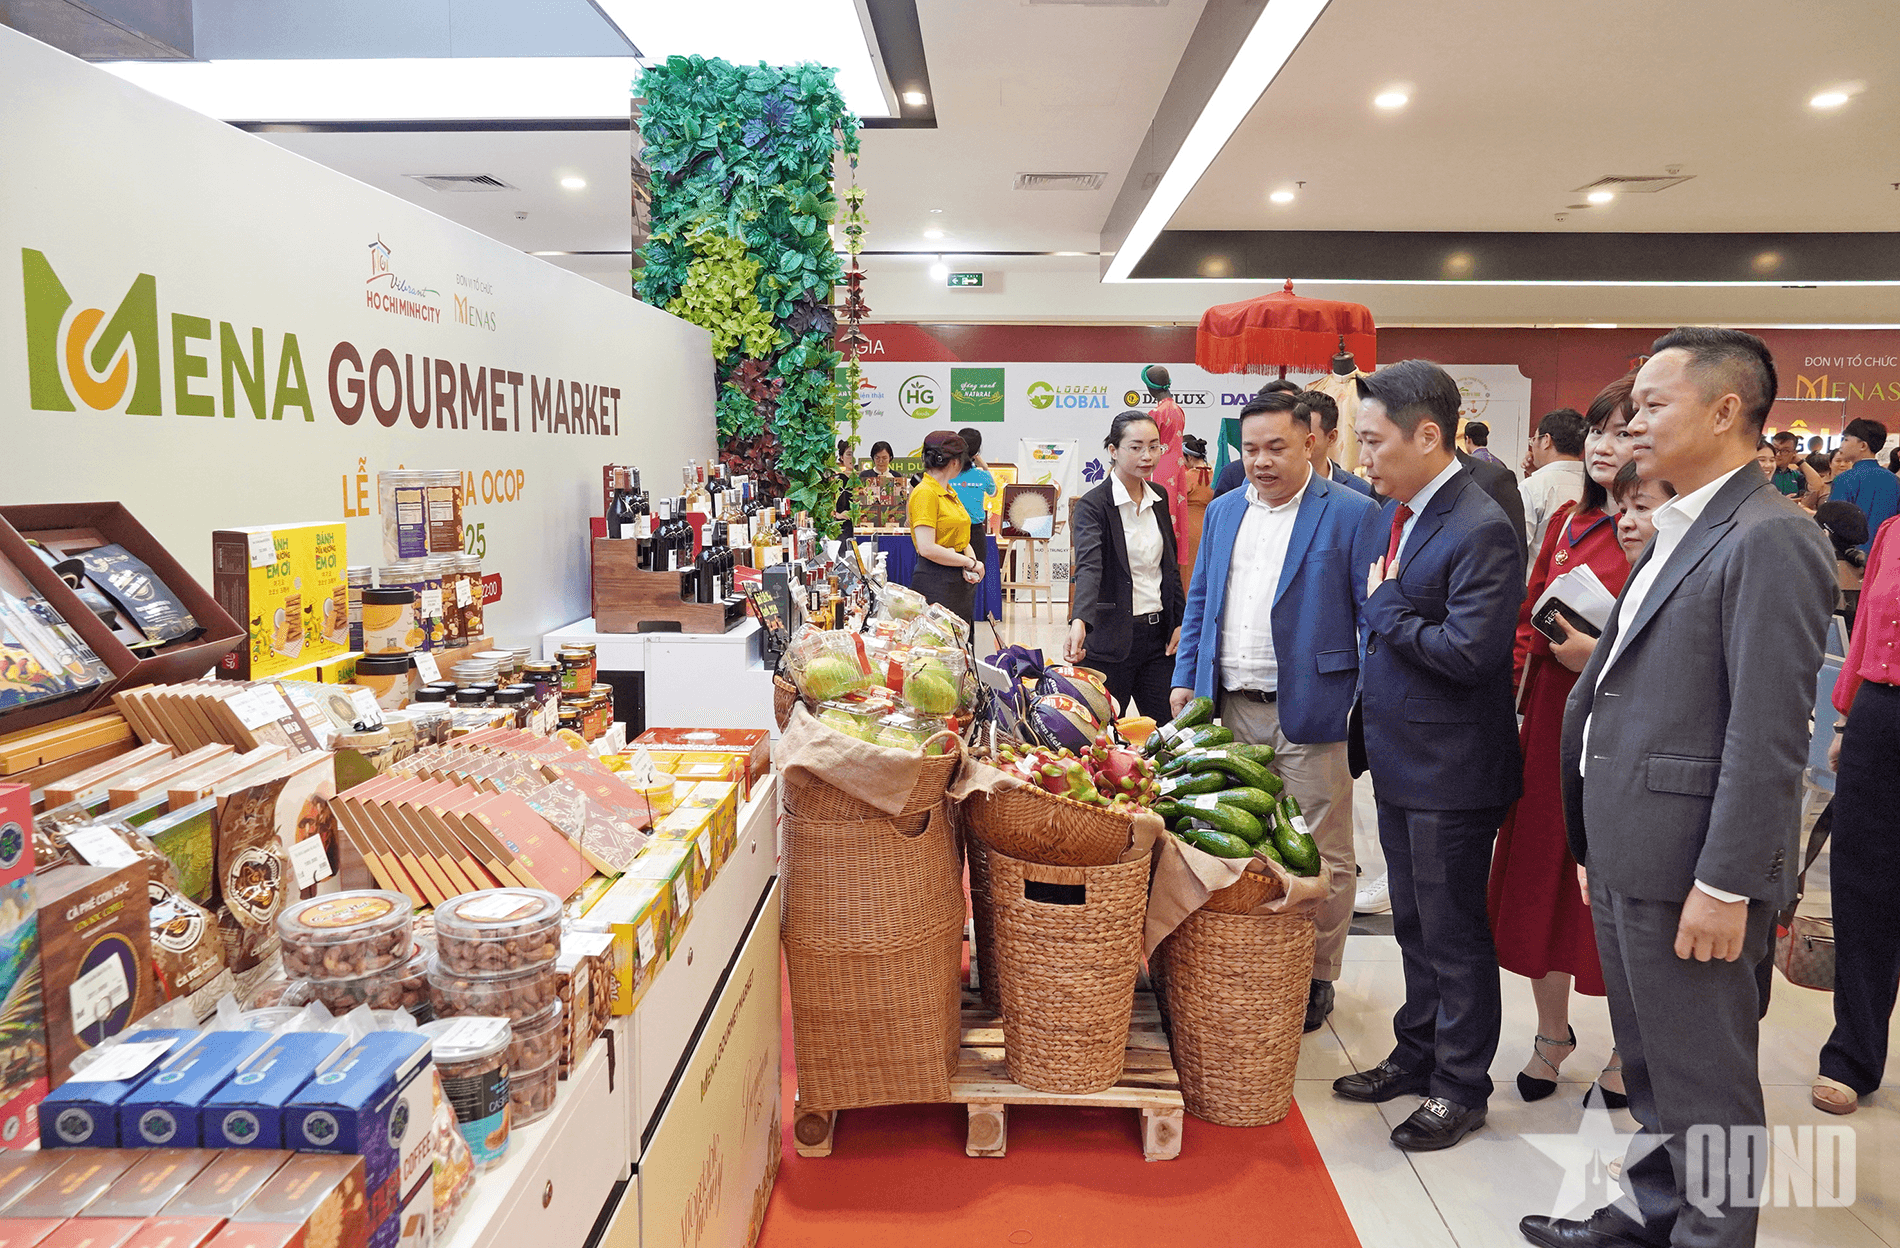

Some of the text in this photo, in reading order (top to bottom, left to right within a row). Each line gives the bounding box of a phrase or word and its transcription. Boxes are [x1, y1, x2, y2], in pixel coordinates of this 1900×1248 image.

[389, 276, 428, 298] Vibrant
[366, 289, 441, 324] HO CHI MINH CITY
[454, 292, 497, 332] MENAS
[21, 247, 621, 436] MENA GOURMET MARKET
[1804, 353, 1898, 369] ĐƠN VỊ TỔ CHỨC
[906, 389, 934, 404] HG
[1056, 385, 1108, 393] LOOFAH
[1796, 374, 1900, 401] MENAS
[342, 456, 370, 518] LỄ
[481, 468, 525, 504] OCOP
[273, 535, 289, 551] ÁNH
[315, 531, 335, 546] BÁNH
[266, 565, 280, 579] EM
[315, 556, 327, 570] EM
[66, 906, 82, 921] CÀ
[81, 896, 97, 916] PHÊ
[403, 1130, 431, 1182] COFFEE
